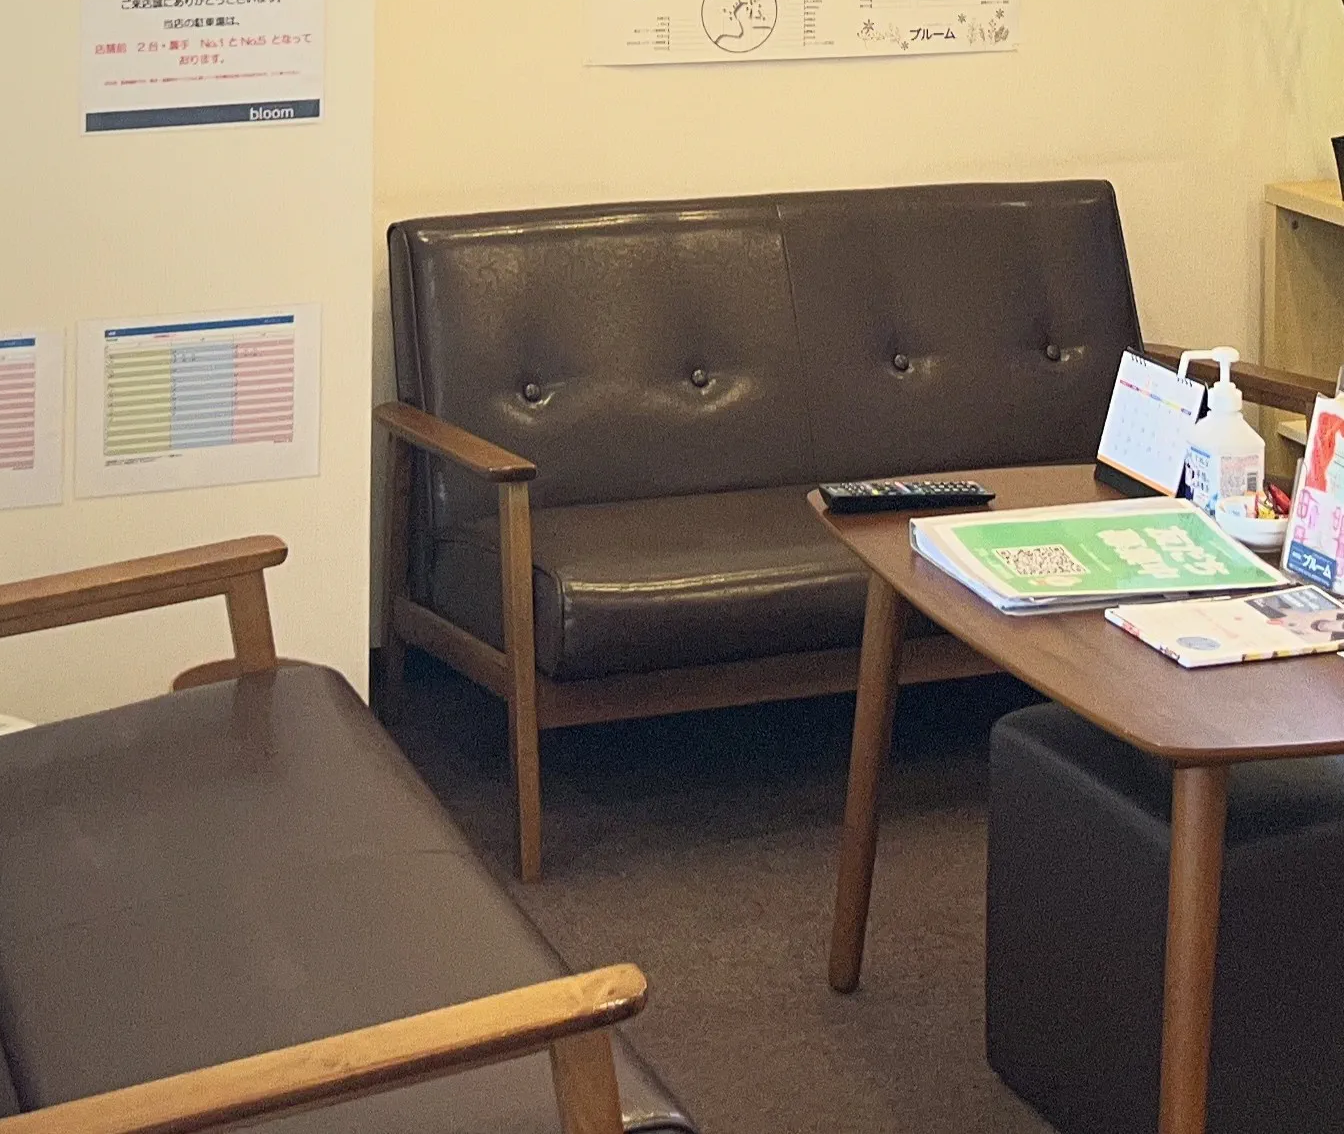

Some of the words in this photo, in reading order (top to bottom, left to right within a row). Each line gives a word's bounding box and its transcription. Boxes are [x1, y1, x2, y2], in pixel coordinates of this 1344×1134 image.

[909, 27, 956, 41] ブルーム
[249, 106, 295, 121] bloom
